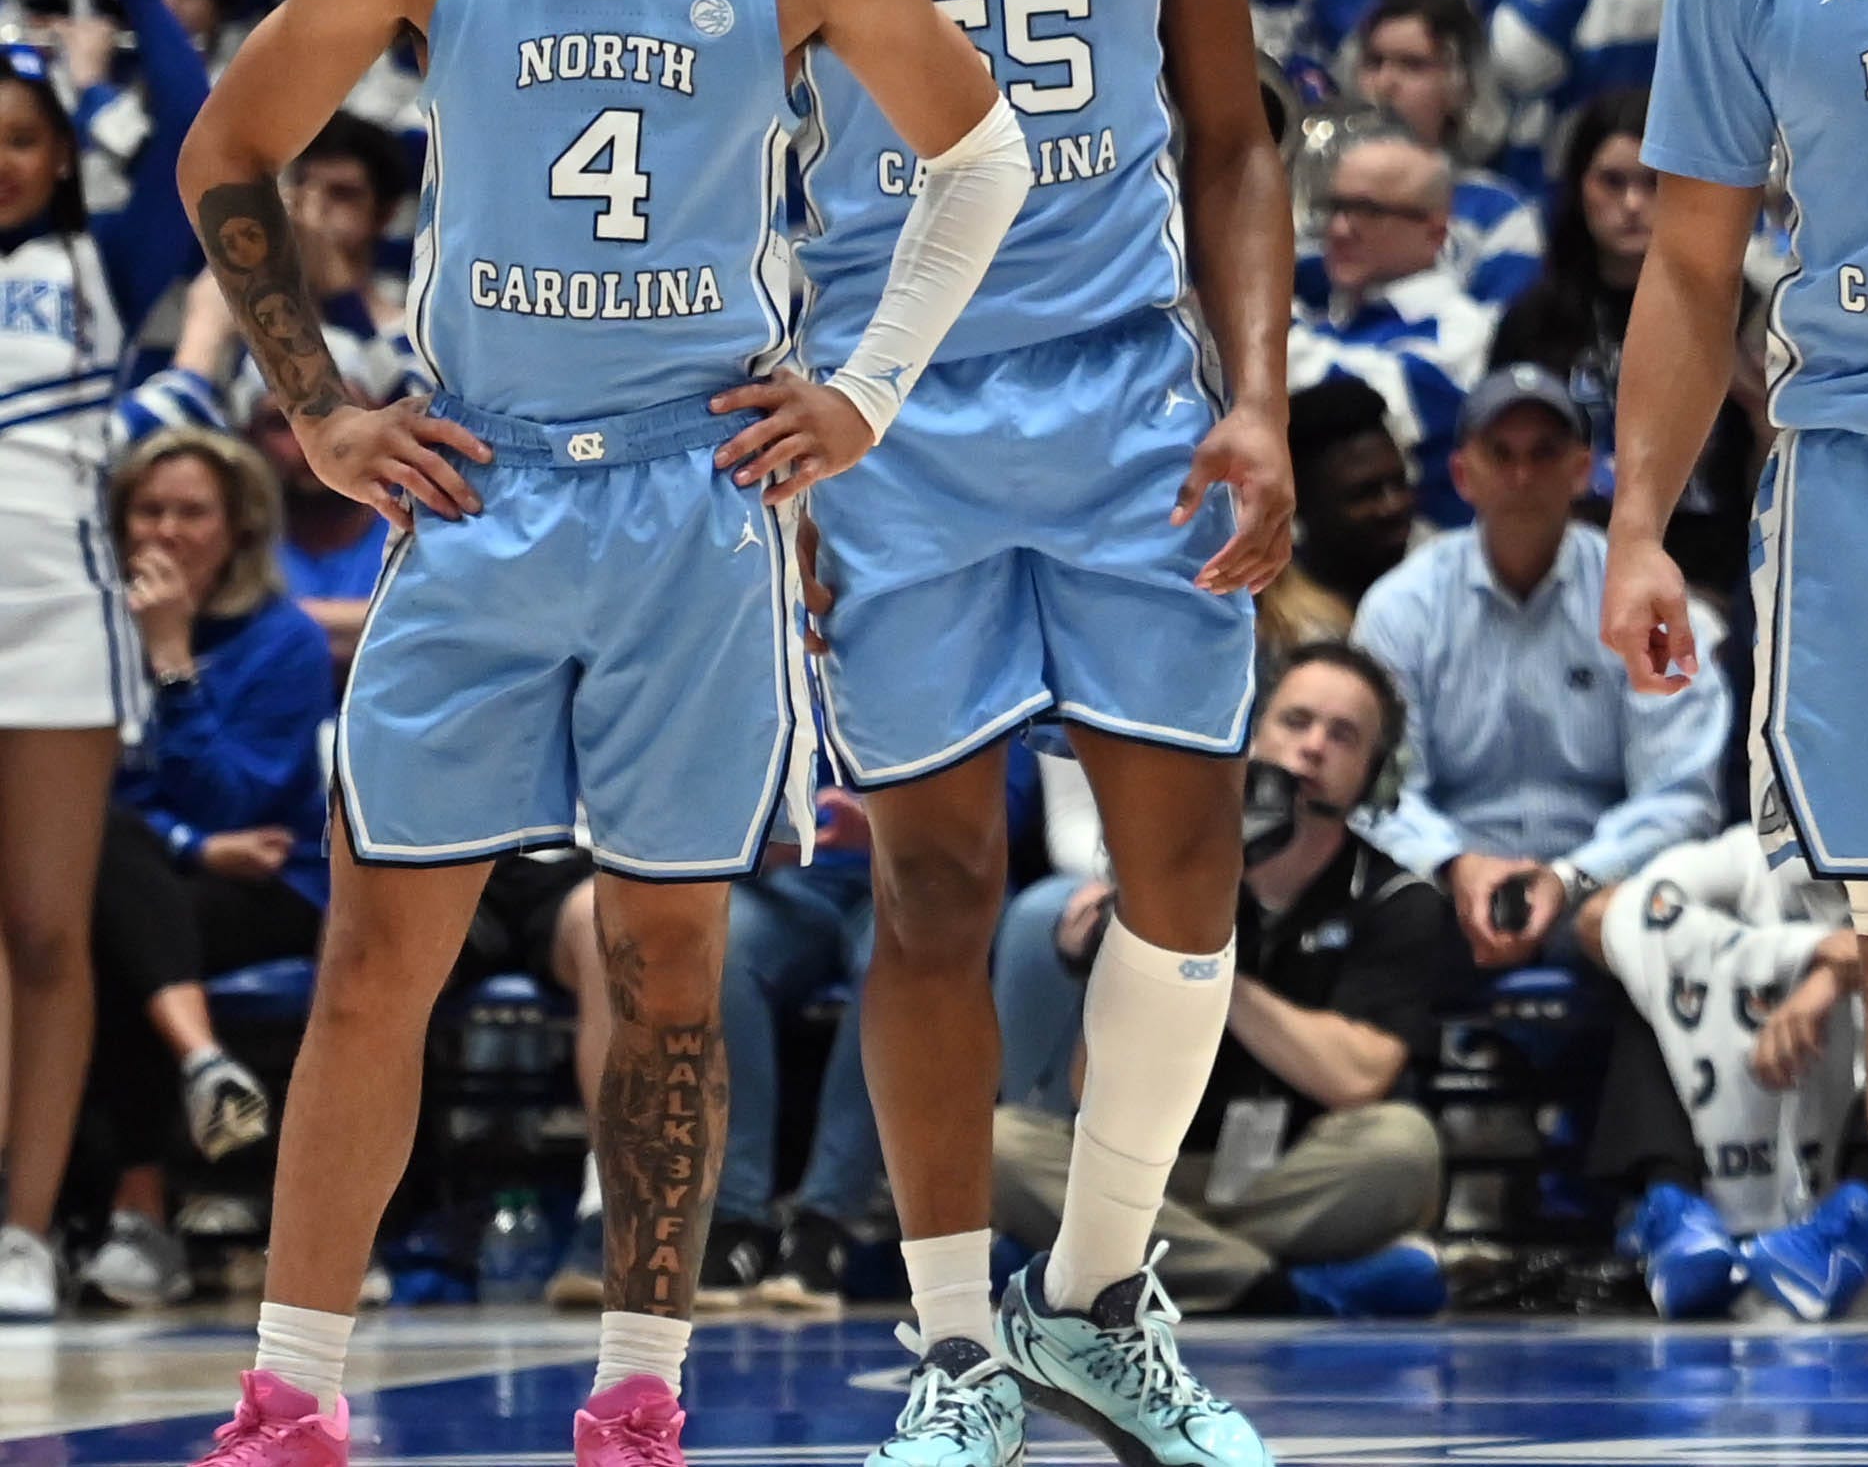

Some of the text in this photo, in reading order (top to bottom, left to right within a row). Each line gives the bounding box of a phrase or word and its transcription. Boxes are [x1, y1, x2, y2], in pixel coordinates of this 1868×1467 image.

[516, 34, 697, 96] NORTH
[548, 108, 652, 243] 4
[469, 258, 724, 320] CAROLINA
[662, 1032, 704, 1145] WALK
